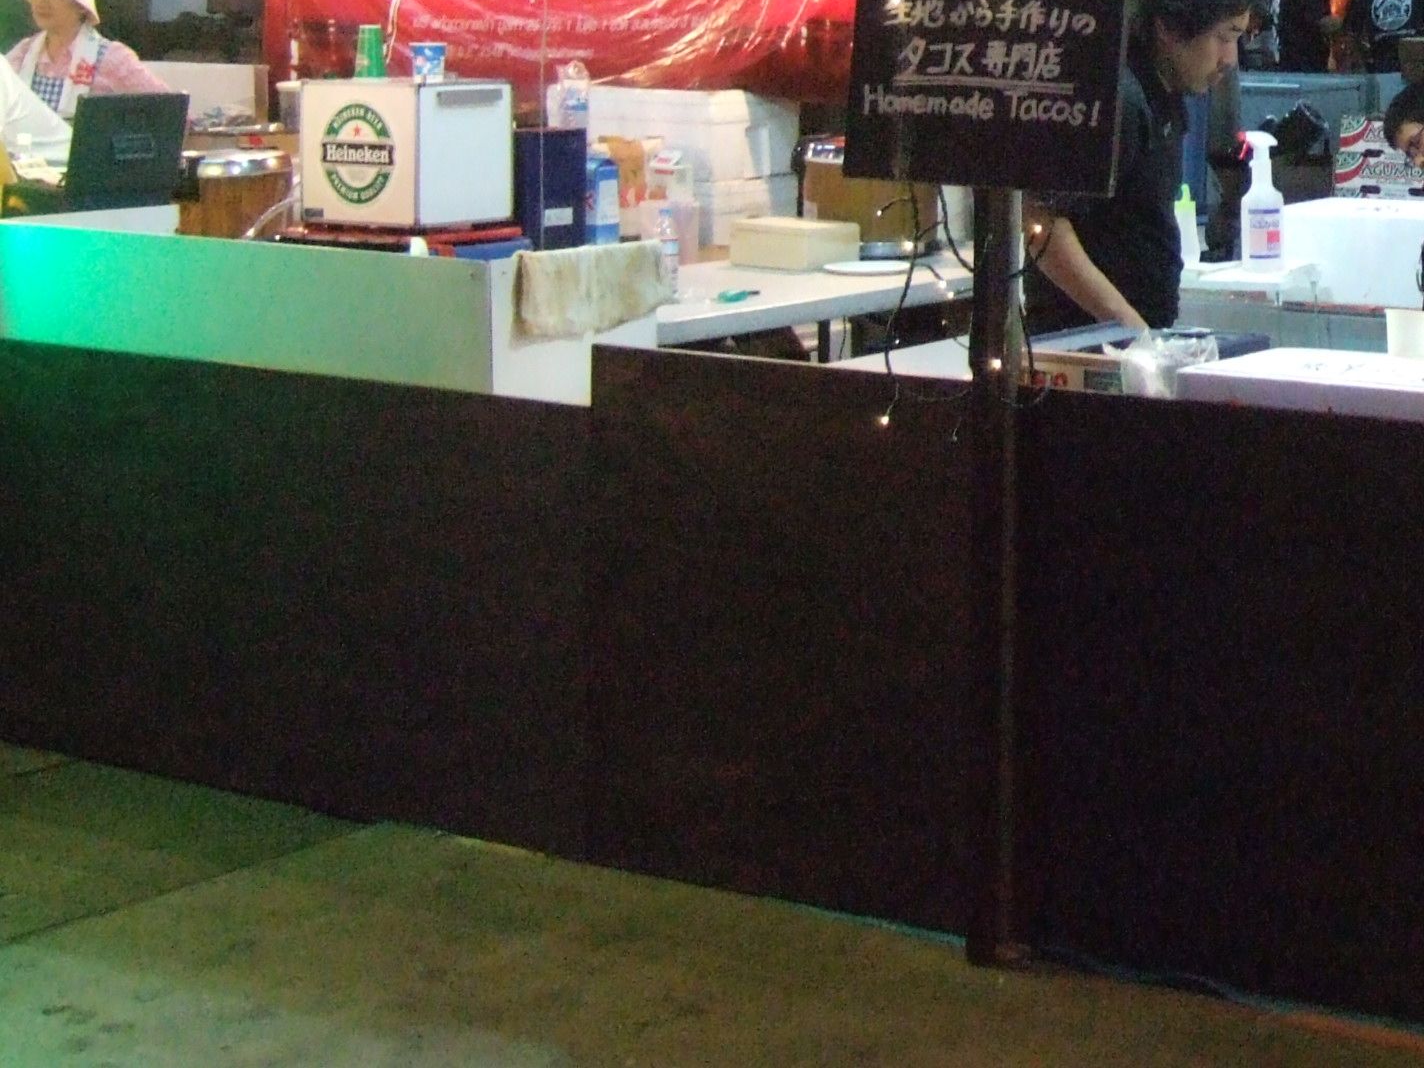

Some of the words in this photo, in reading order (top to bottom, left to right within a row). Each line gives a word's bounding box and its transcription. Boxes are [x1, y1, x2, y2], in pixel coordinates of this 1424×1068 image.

[863, 83, 995, 120] Homemade
[1002, 86, 1100, 127] Tacos!
[326, 143, 390, 164] Heineken
